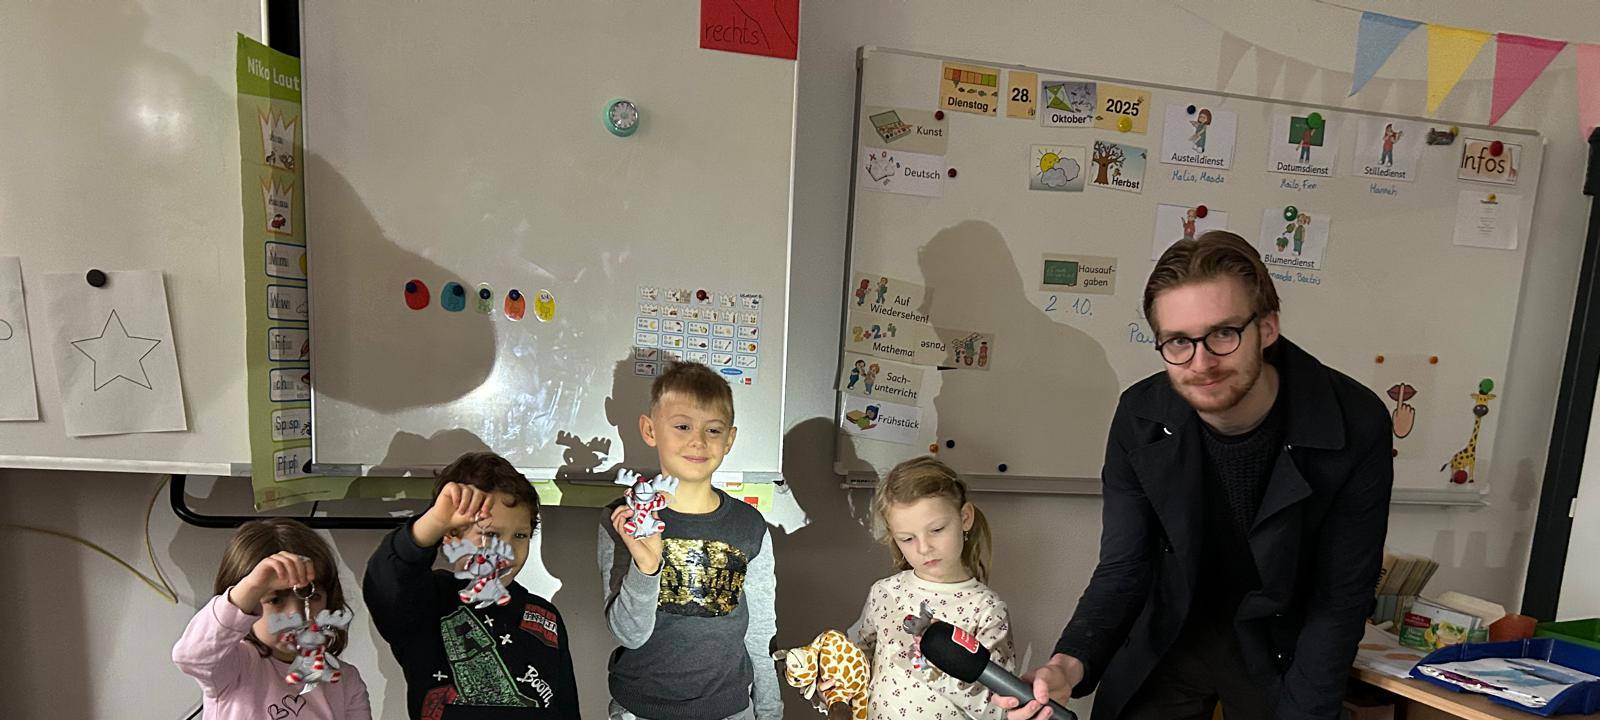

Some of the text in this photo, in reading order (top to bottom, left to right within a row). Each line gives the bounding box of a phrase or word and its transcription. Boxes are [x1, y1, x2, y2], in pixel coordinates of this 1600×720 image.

[704, 16, 759, 45] rechts
[247, 56, 300, 92] Niko Laut
[1011, 87, 1032, 103] 28.
[947, 96, 989, 112] Dienstag
[1105, 98, 1140, 117] 2025
[1051, 113, 1087, 125] Oktober
[916, 126, 943, 138] Kunst
[1171, 152, 1225, 167] Austeildienst
[1461, 143, 1506, 174] Infos
[904, 167, 941, 180] Deutsch
[1276, 161, 1329, 176] Datumsdienst
[1363, 166, 1406, 179] Stilledienst
[1111, 176, 1140, 190] Herbst
[1264, 253, 1315, 268] Blumendienst
[1078, 265, 1116, 275] Hausauf-
[1083, 277, 1108, 288] gaben
[894, 295, 912, 307] Auf
[870, 303, 930, 324] Wiedersehen!
[872, 341, 915, 357] Mathema
[886, 372, 911, 384] Sach-
[874, 384, 918, 399] unterricht
[877, 413, 920, 429] Frühstück
